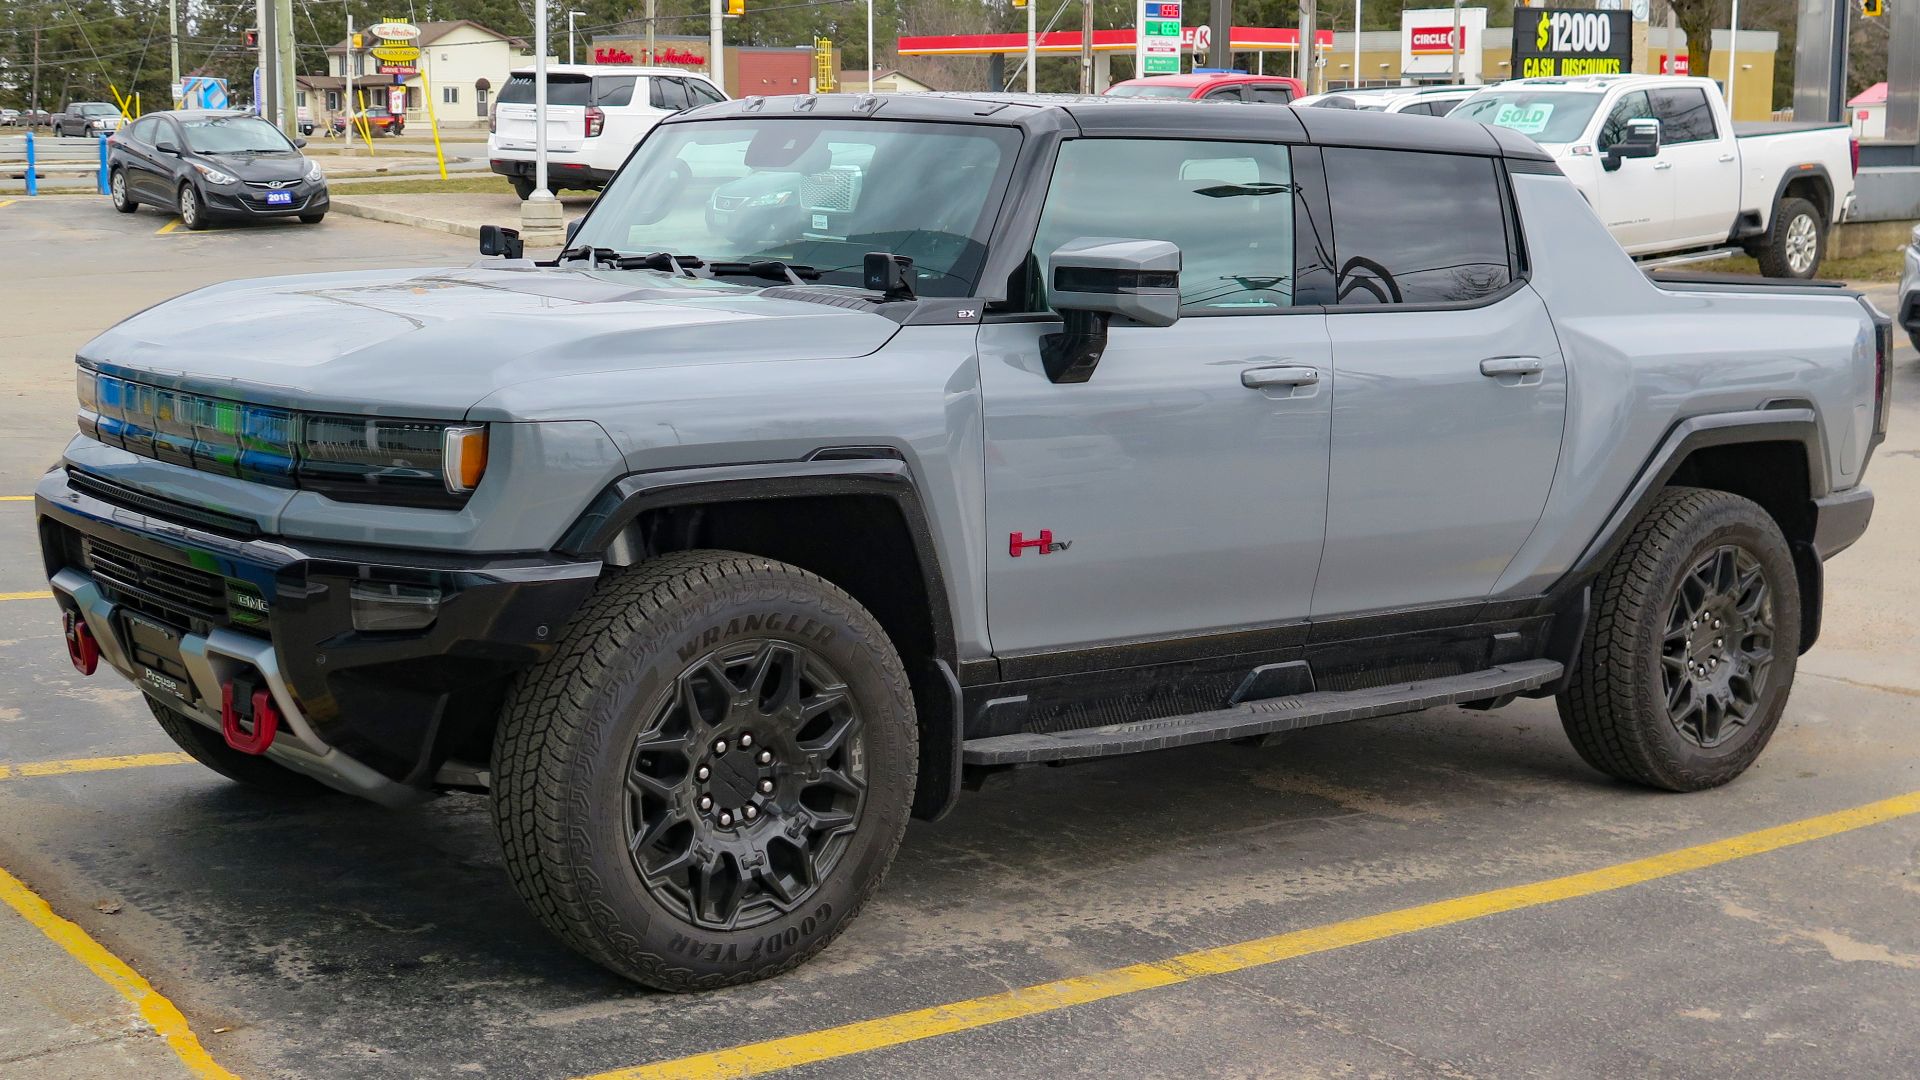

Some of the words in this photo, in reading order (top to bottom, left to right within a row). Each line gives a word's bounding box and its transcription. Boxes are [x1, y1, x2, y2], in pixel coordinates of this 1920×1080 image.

[1200, 30, 1210, 47] K
[1413, 33, 1448, 45] CIRCLE
[1536, 11, 1611, 52] $12000
[1523, 58, 1555, 78] CASH
[1561, 58, 1621, 76] DISCOUNTS
[1500, 110, 1545, 122] SOLD
[268, 193, 290, 202] 2015
[957, 309, 975, 318] 2X
[237, 594, 270, 613] GMC
[676, 612, 836, 664] WRANGLER
[145, 667, 177, 690] Prouse
